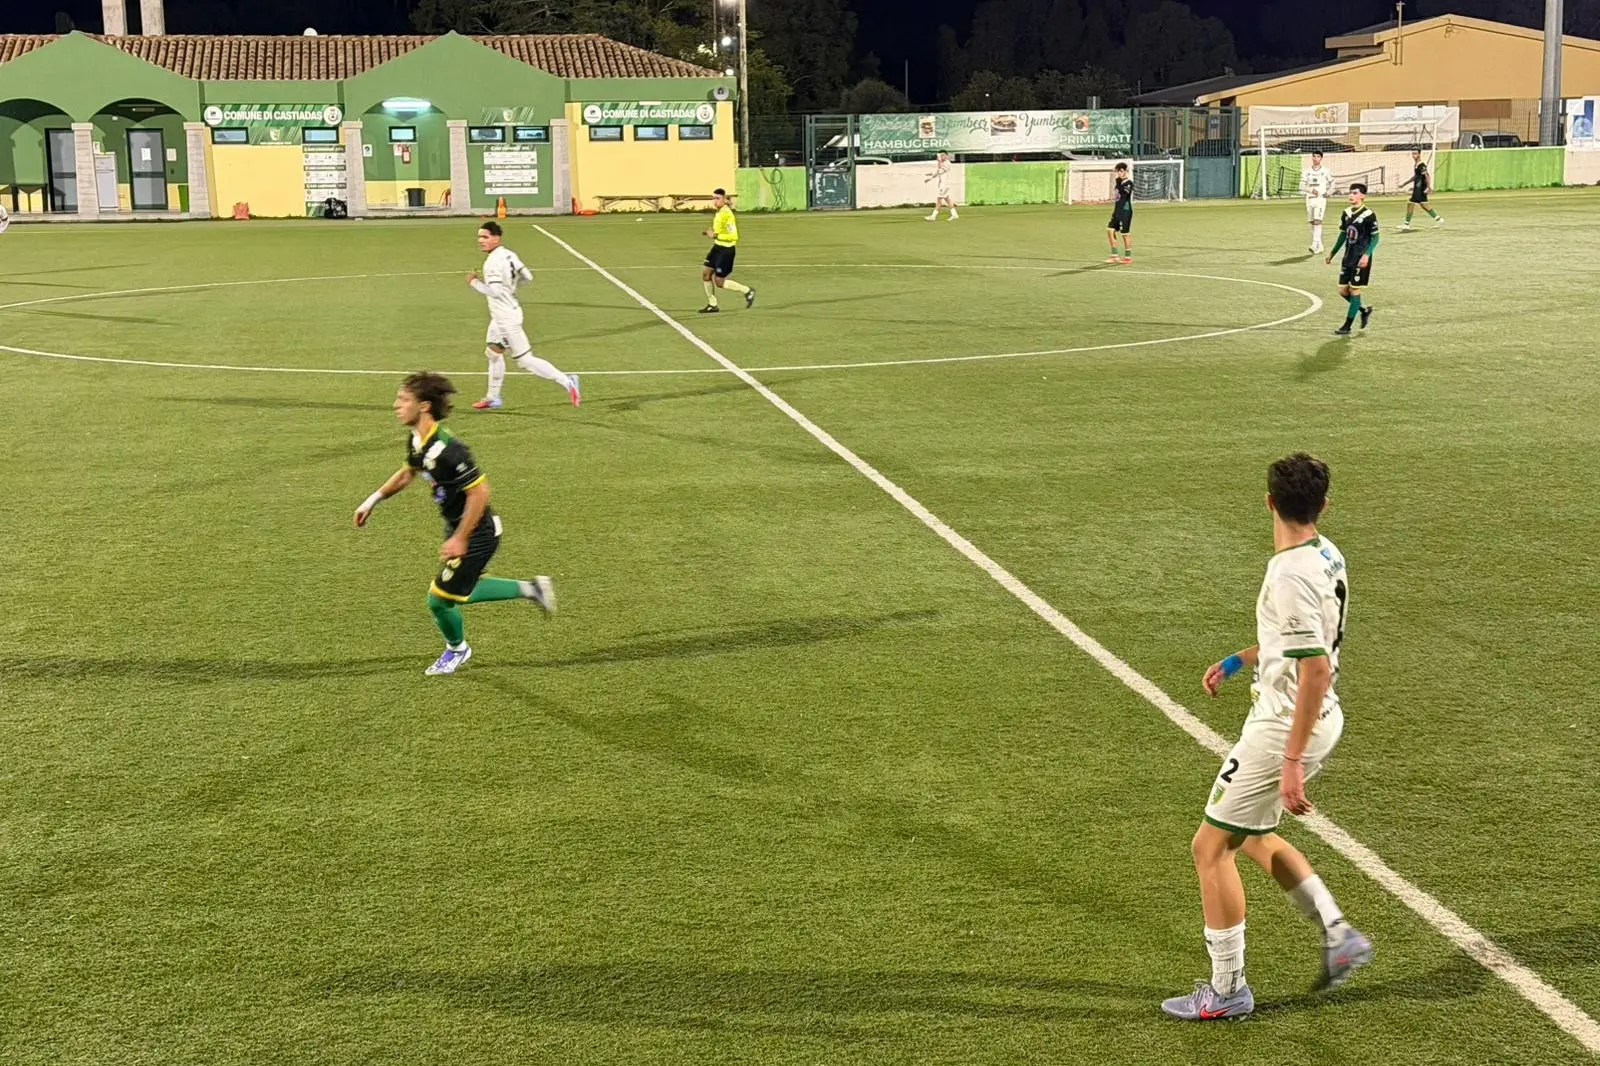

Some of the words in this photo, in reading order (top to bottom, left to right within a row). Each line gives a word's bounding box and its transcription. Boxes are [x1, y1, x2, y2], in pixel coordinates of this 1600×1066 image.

[224, 111, 262, 120] COMUNE
[263, 111, 273, 120] DI
[274, 111, 323, 120] CASTIADAS
[603, 110, 638, 118] COMUNE
[640, 110, 649, 118] DI
[650, 109, 695, 118] CASTIADAS
[863, 139, 951, 149] HAMBUGERIA
[1060, 135, 1094, 144] PRIMI
[1220, 758, 1239, 783] 2
